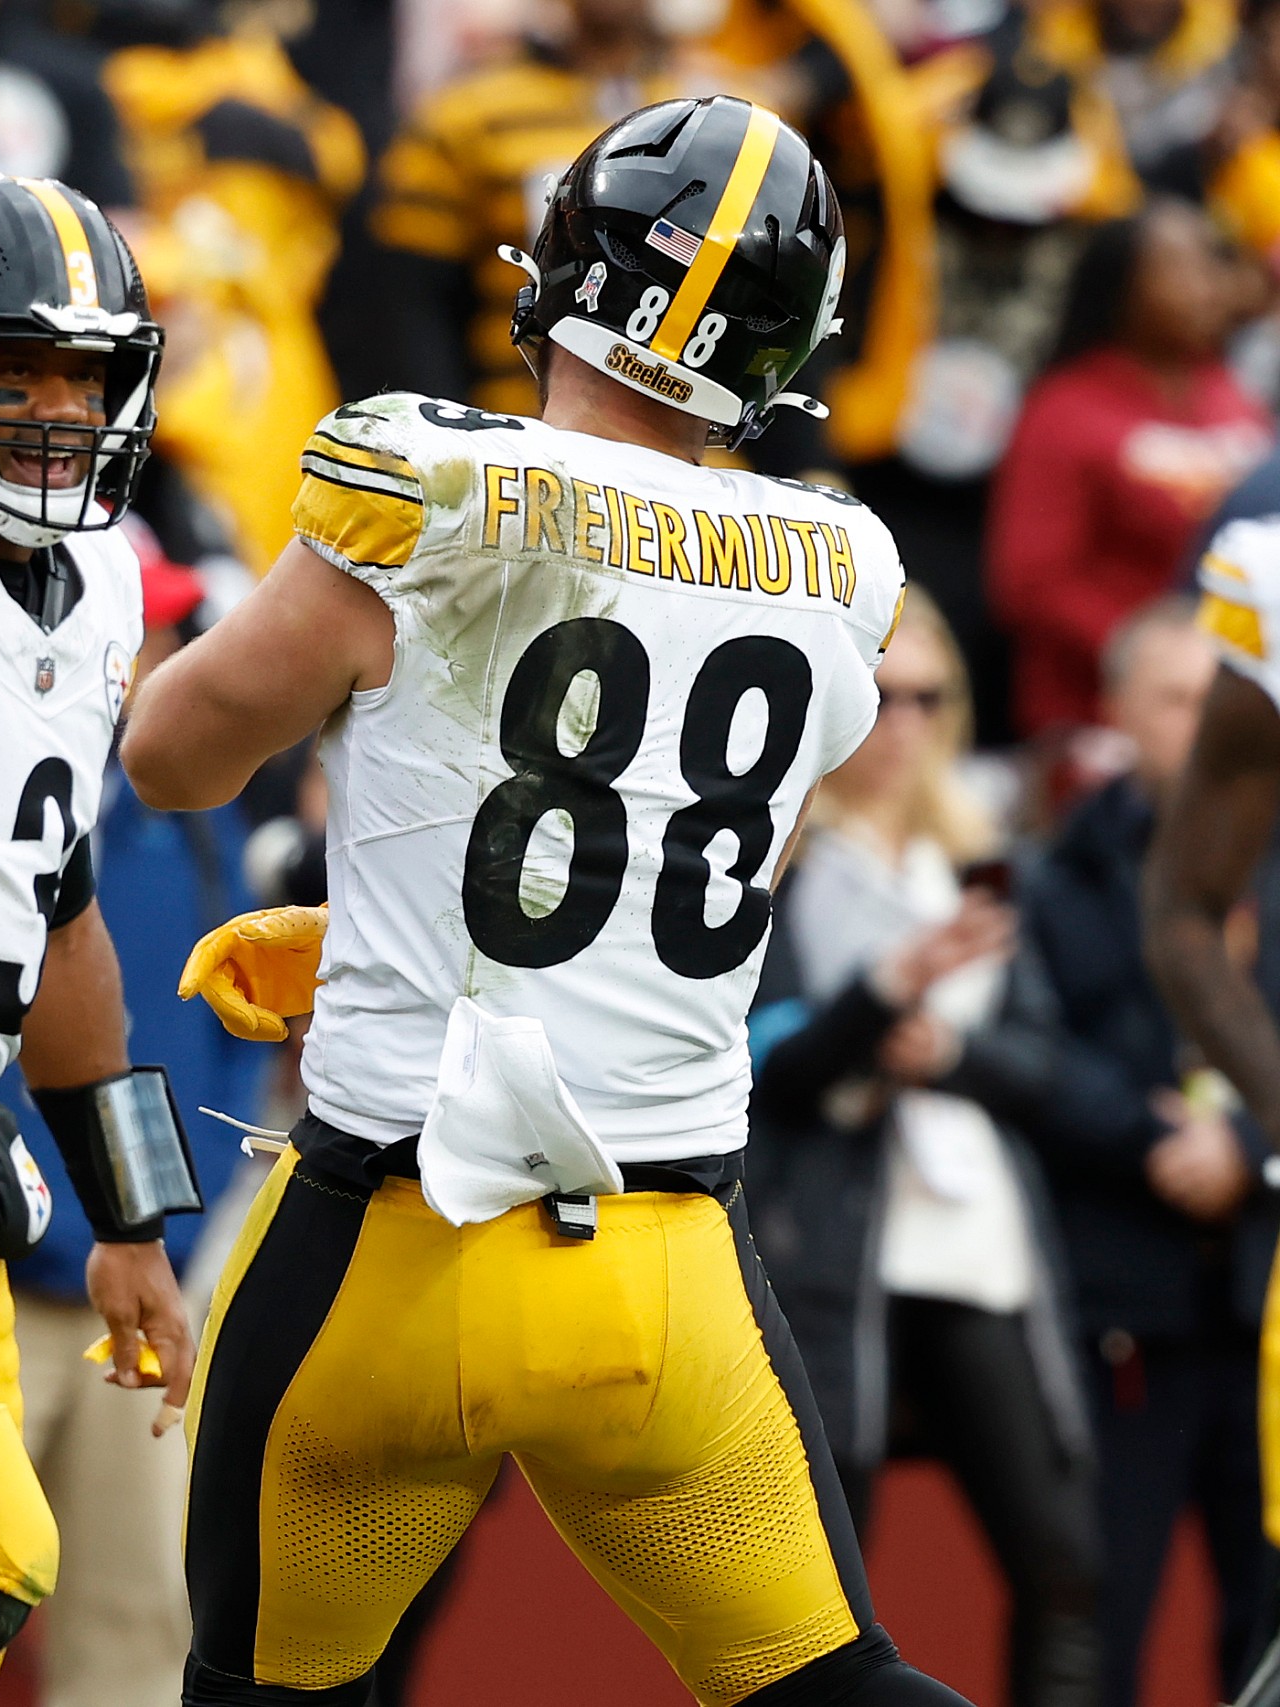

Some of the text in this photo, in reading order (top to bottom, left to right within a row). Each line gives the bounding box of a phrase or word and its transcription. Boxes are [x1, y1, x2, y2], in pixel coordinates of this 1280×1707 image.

[68, 251, 97, 306] 3
[605, 343, 694, 403] Steelers
[482, 463, 858, 609] FREIERMUTH
[461, 616, 814, 980] 88
